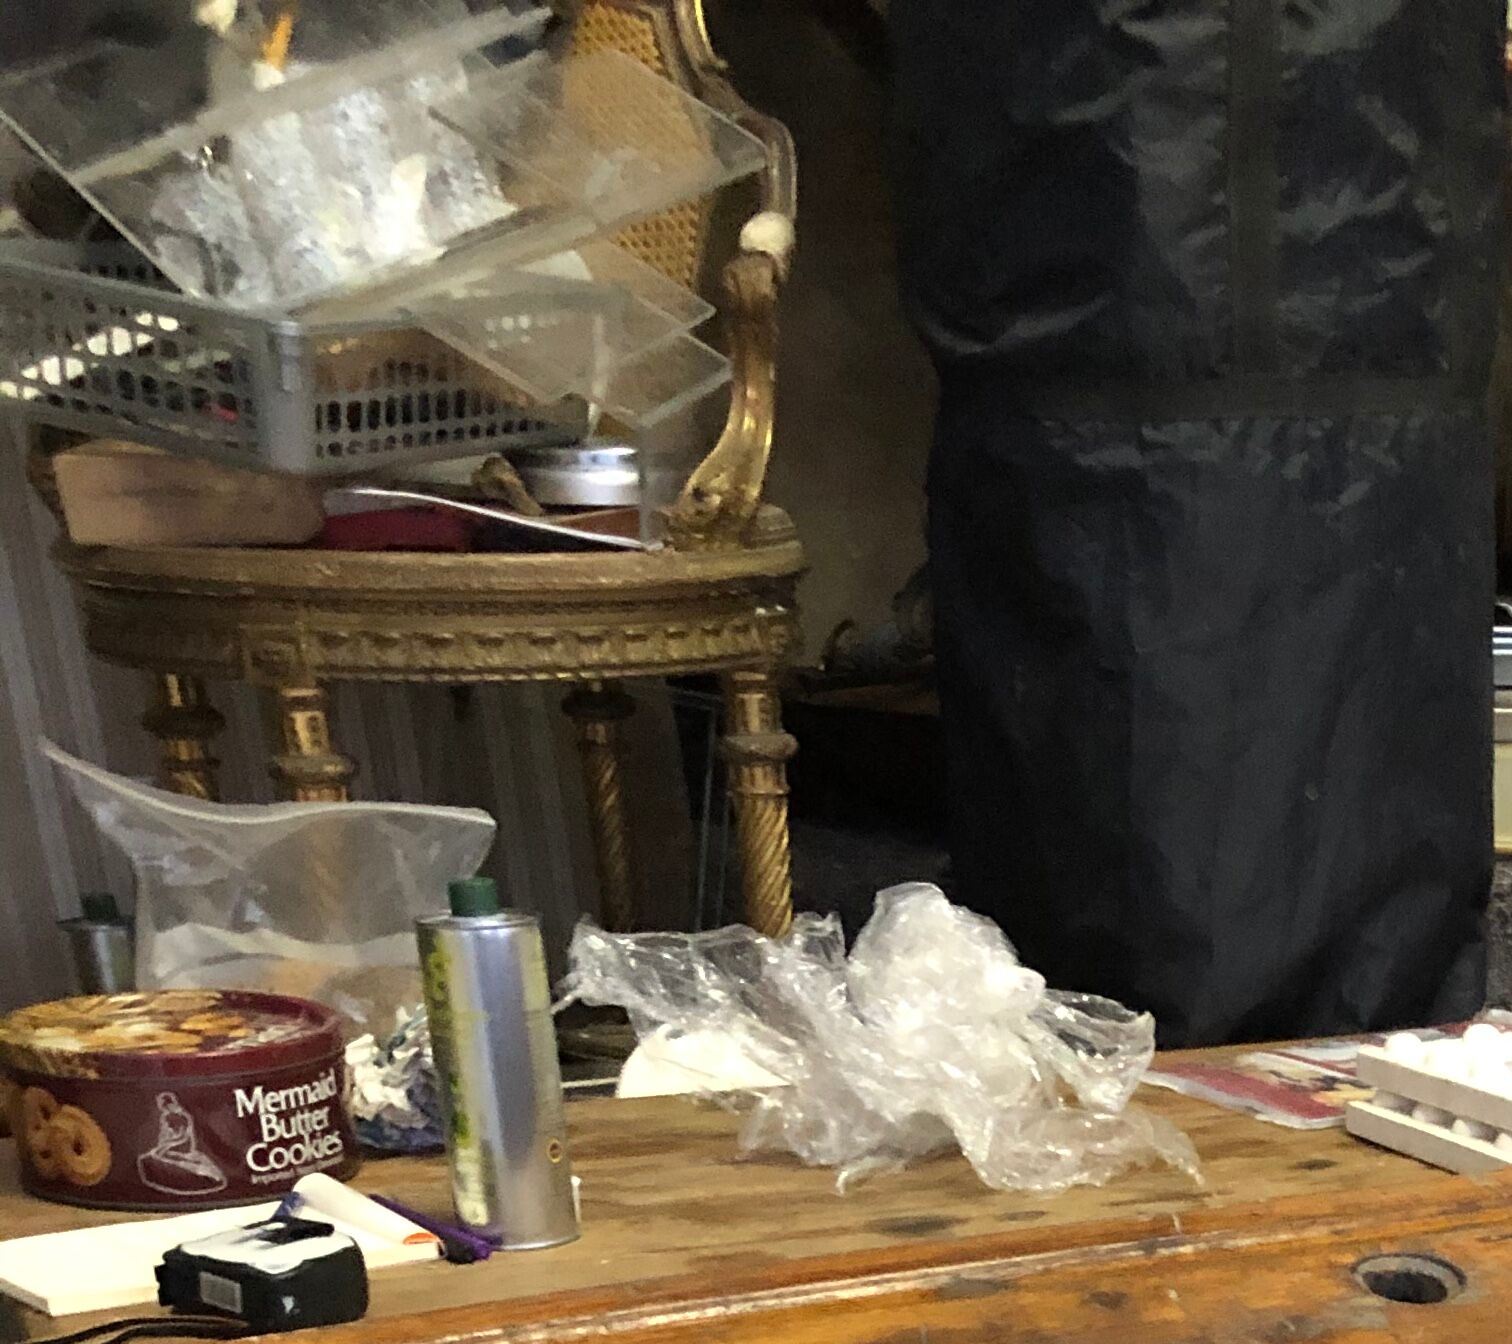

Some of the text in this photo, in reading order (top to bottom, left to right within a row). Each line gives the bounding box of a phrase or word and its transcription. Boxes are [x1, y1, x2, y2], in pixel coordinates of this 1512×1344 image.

[233, 1067, 338, 1118] Mermaid
[260, 1106, 330, 1142] Butter
[246, 1131, 343, 1172] Cookies
